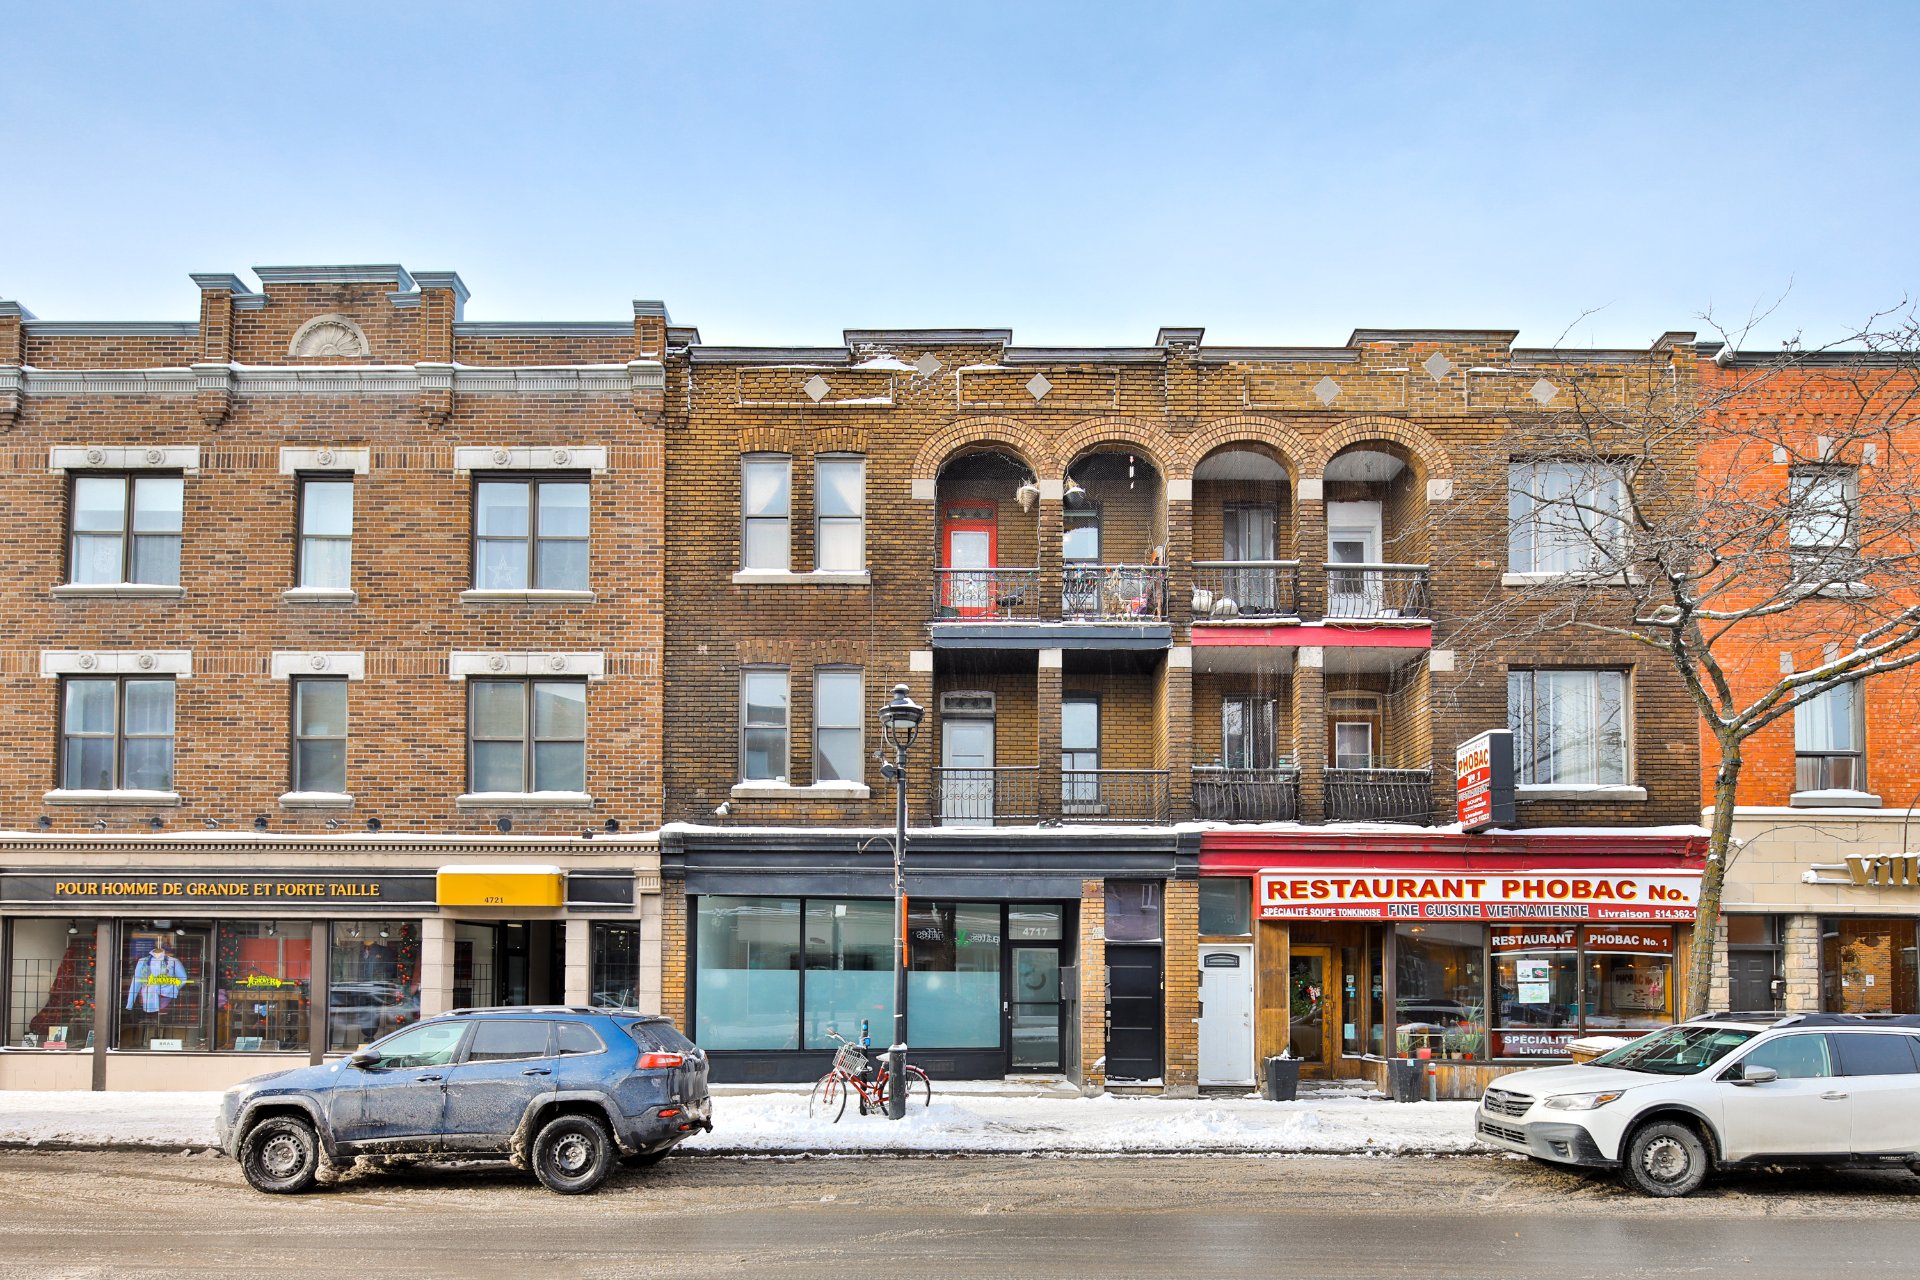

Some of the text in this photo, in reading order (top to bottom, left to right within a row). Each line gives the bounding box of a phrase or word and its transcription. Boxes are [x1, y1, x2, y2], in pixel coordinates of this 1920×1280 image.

[1458, 748, 1489, 776] PHOBAC
[1844, 856, 1920, 886] Vill
[55, 882, 380, 896] POUR HOMME DE GRANDE ET FORTE TAILLE
[1267, 879, 1690, 901] RESTAURANT PHOBAC No.
[484, 896, 504, 904] 4721
[1263, 906, 1381, 917] SPÉCIALITÉ SOUPE TONKINOISE
[1387, 904, 1589, 918] FINE CUISINE VIETNAMIENNE
[1598, 909, 1697, 918] Livraison 514.362-1
[1022, 927, 1048, 937] 4717
[1491, 933, 1573, 946] RESTAURANT
[1589, 934, 1668, 947] PHOBAC No. 1
